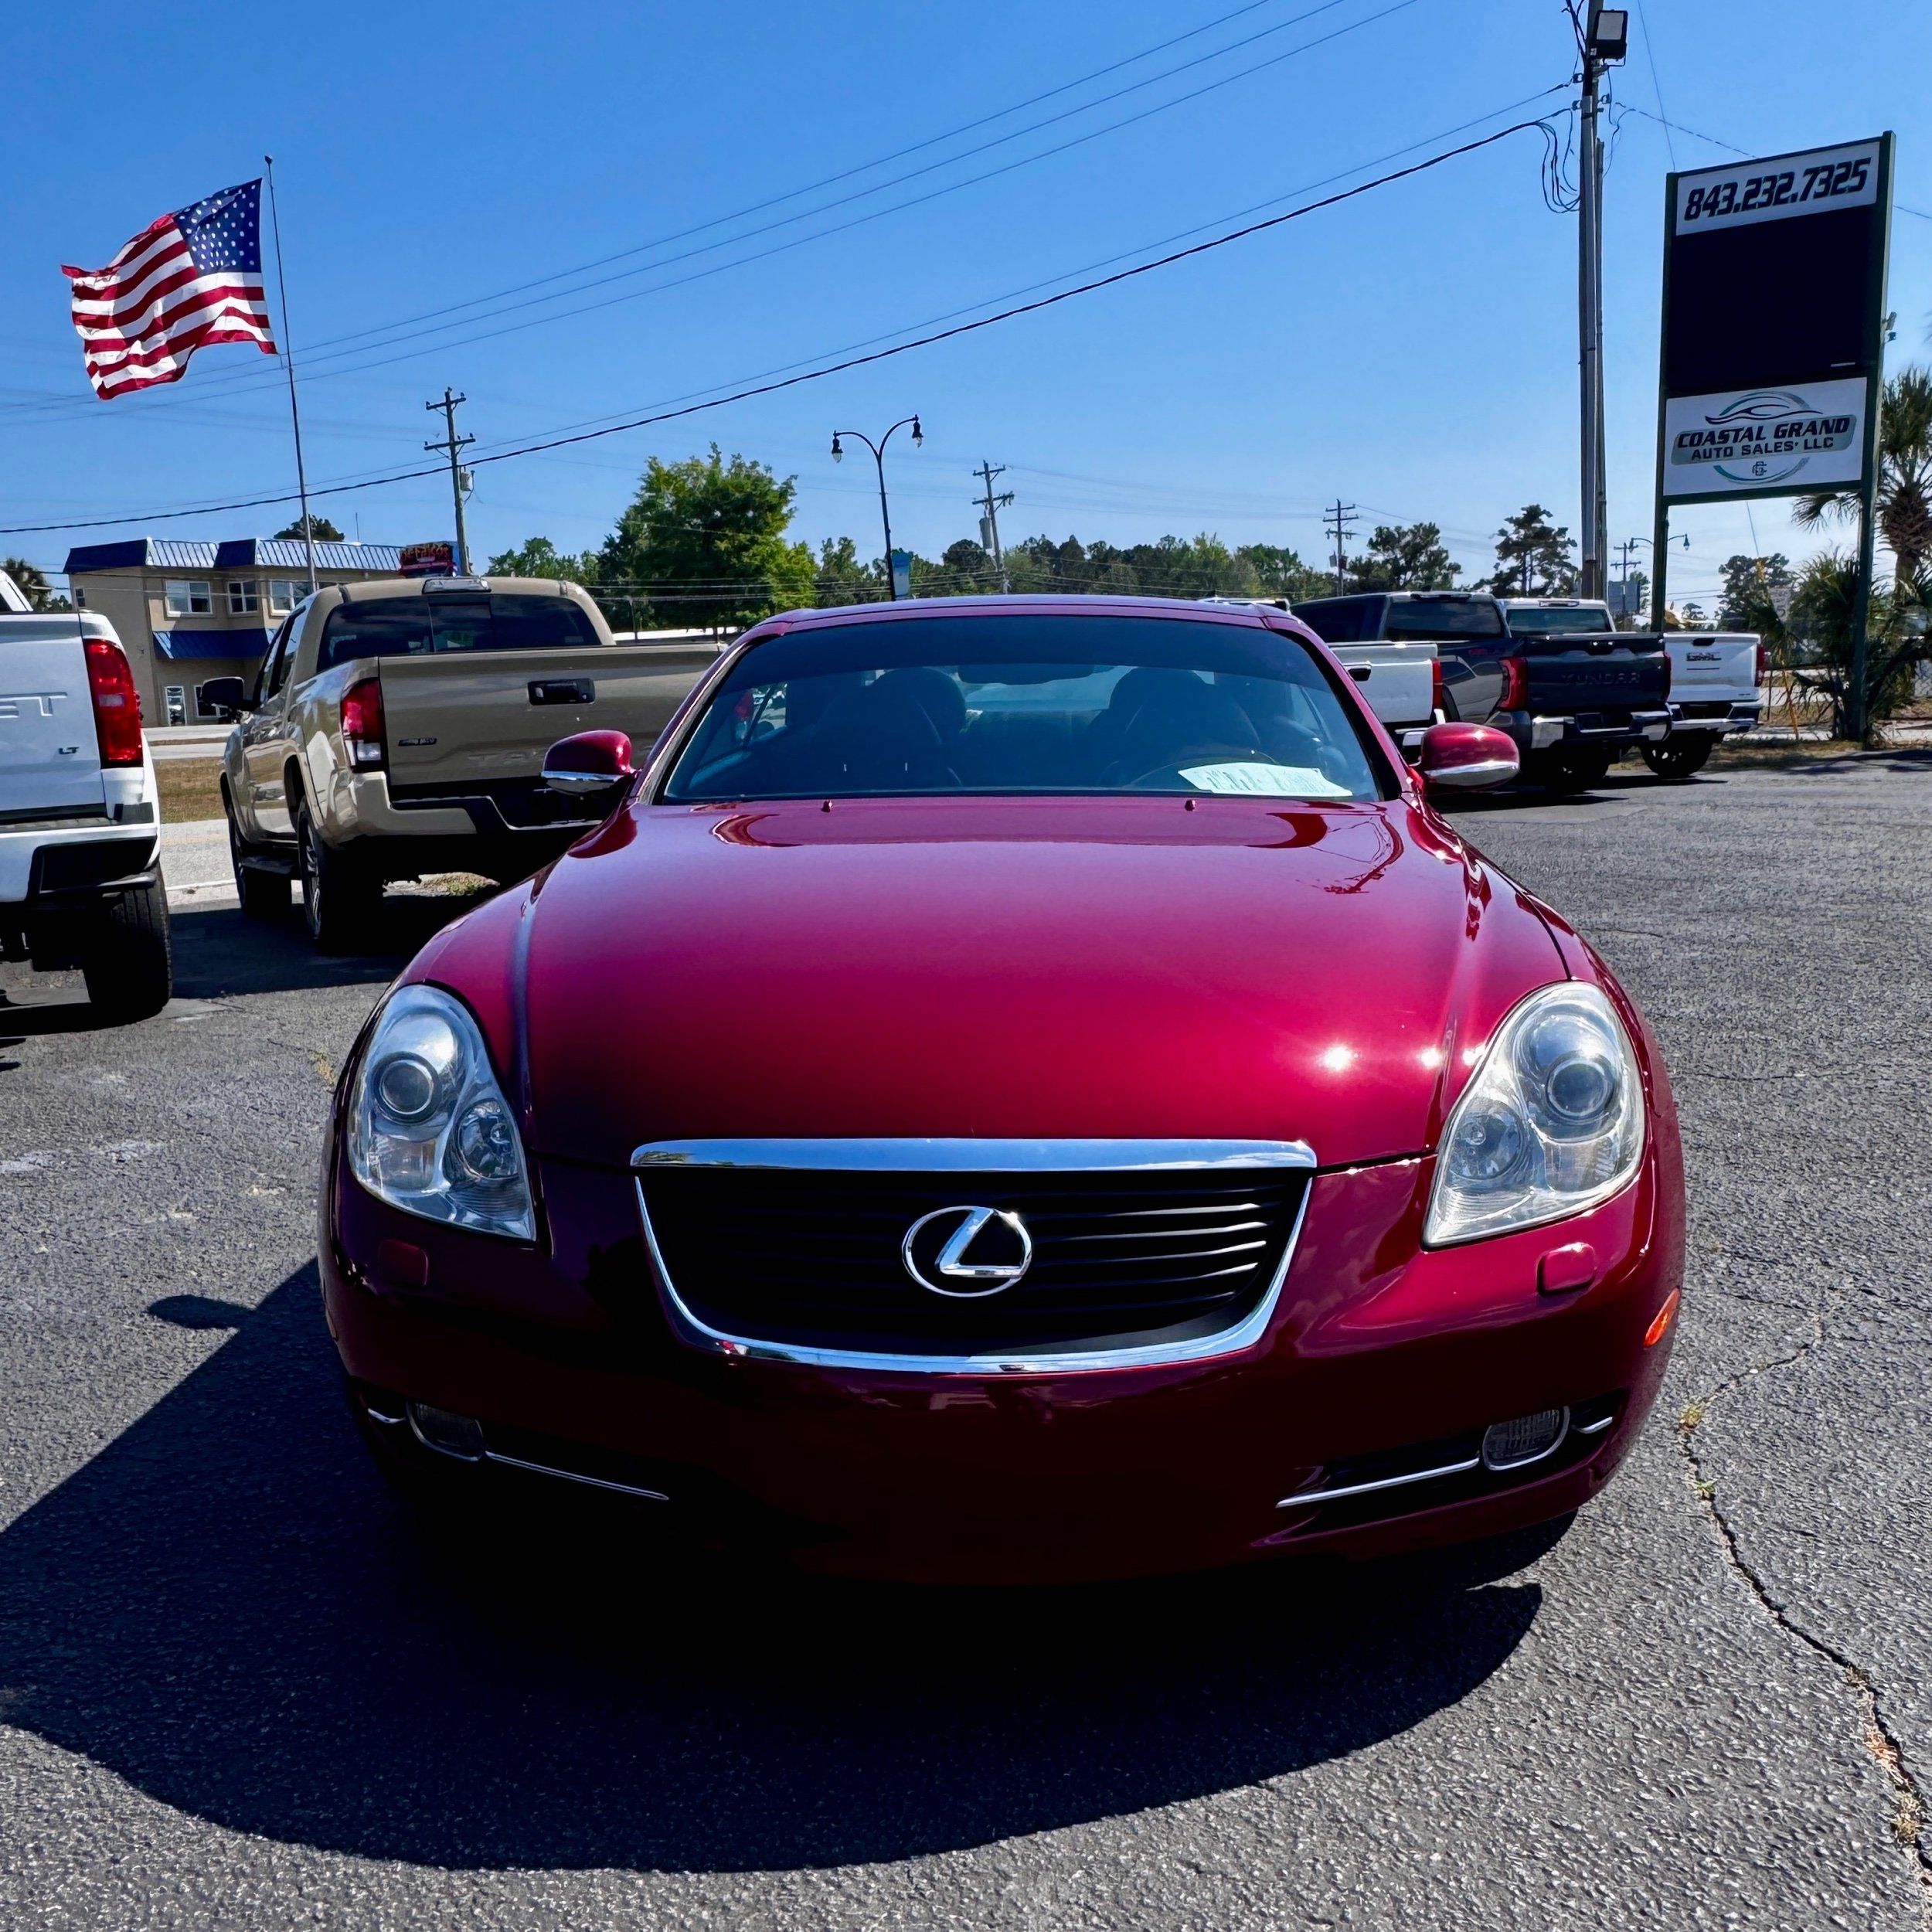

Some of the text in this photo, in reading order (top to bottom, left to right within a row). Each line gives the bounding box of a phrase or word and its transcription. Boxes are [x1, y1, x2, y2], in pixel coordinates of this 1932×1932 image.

[1684, 157, 1872, 221] 843.232.7325
[1677, 417, 1851, 448] COASTAL GRAND
[1691, 447, 1733, 461] AUTO
[1804, 437, 1834, 451] LLC
